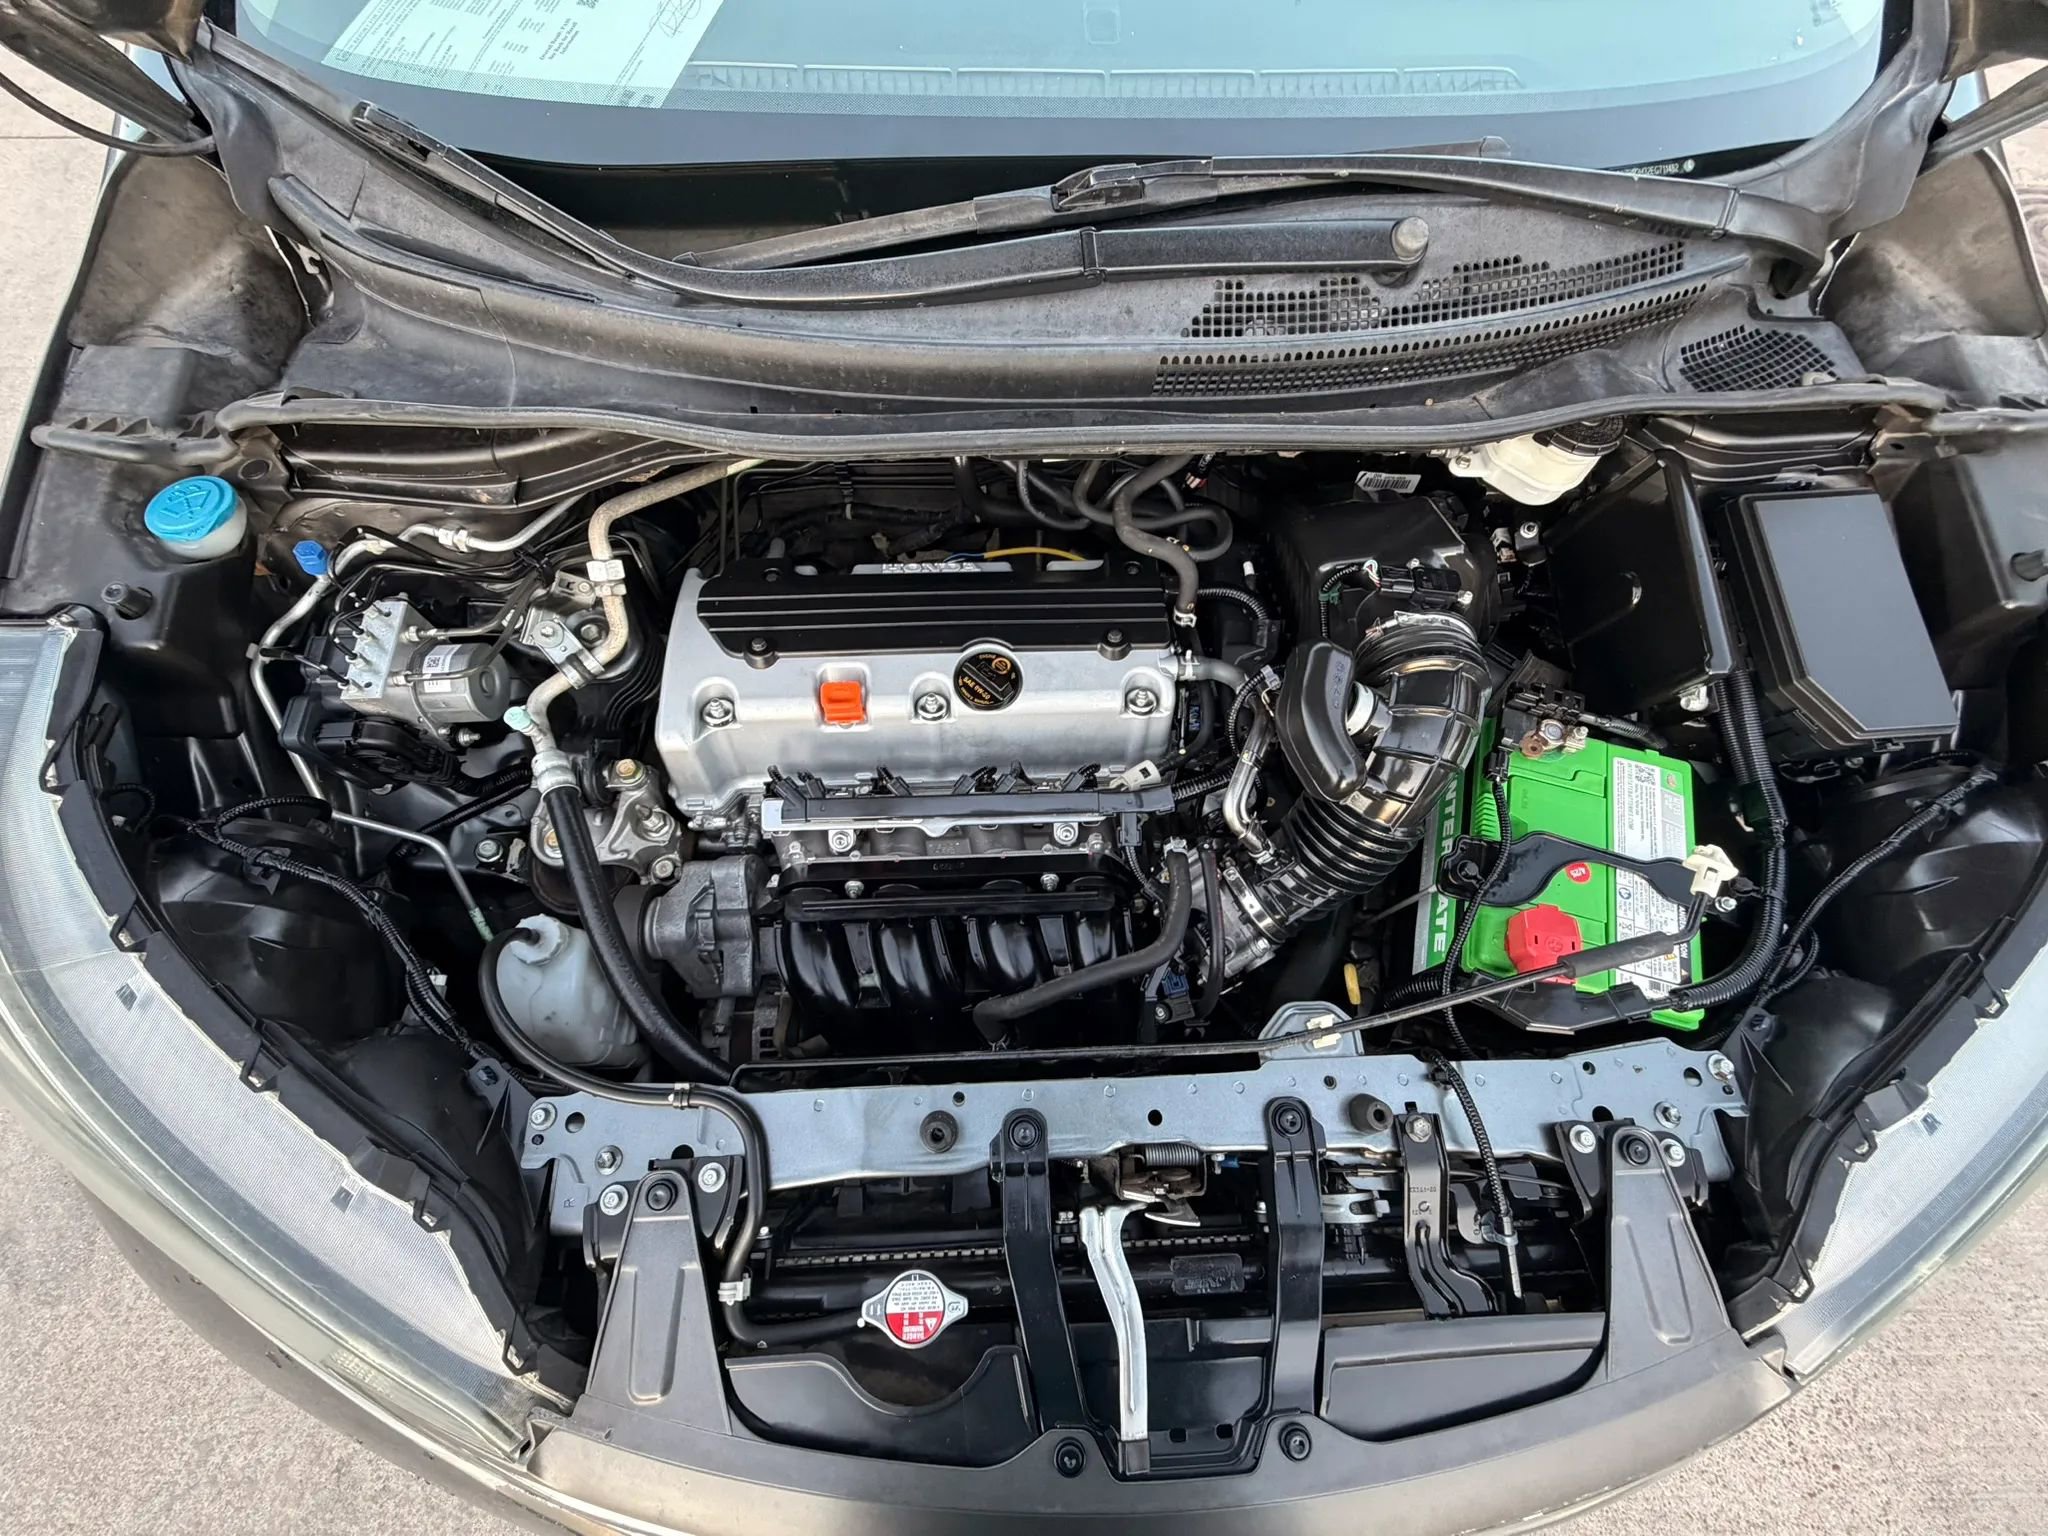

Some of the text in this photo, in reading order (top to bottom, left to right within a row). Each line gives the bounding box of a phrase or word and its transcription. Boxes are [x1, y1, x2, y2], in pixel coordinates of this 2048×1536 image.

[882, 562, 982, 574] HONDA
[962, 675, 976, 689] SAE
[1433, 778, 1458, 953] NTERATE
